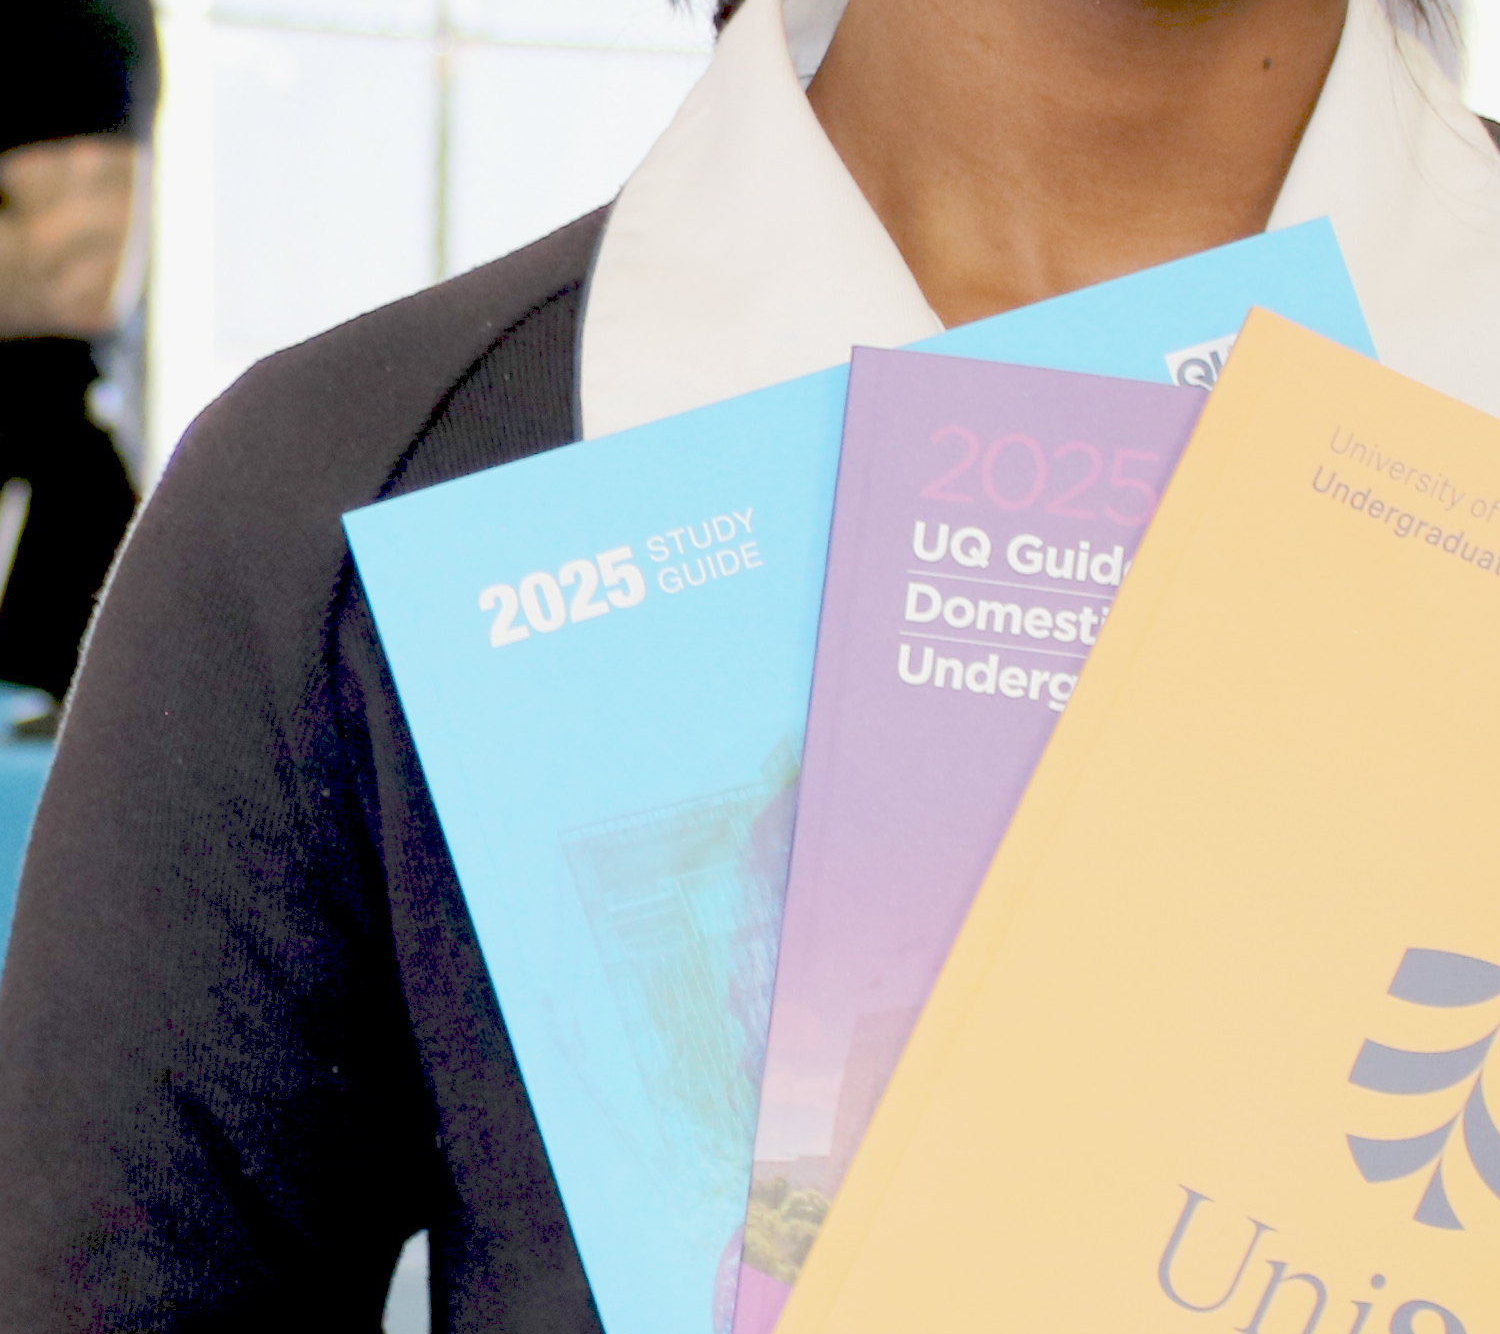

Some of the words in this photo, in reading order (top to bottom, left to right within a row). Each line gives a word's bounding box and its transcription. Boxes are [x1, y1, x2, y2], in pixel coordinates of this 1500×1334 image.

[919, 425, 1161, 528] 2025
[1330, 425, 1466, 512] University
[478, 544, 647, 648] 2025
[646, 507, 755, 563] STUDY
[656, 540, 765, 595] GUIDE
[912, 520, 992, 569] UQ
[1006, 533, 1133, 587] Guid
